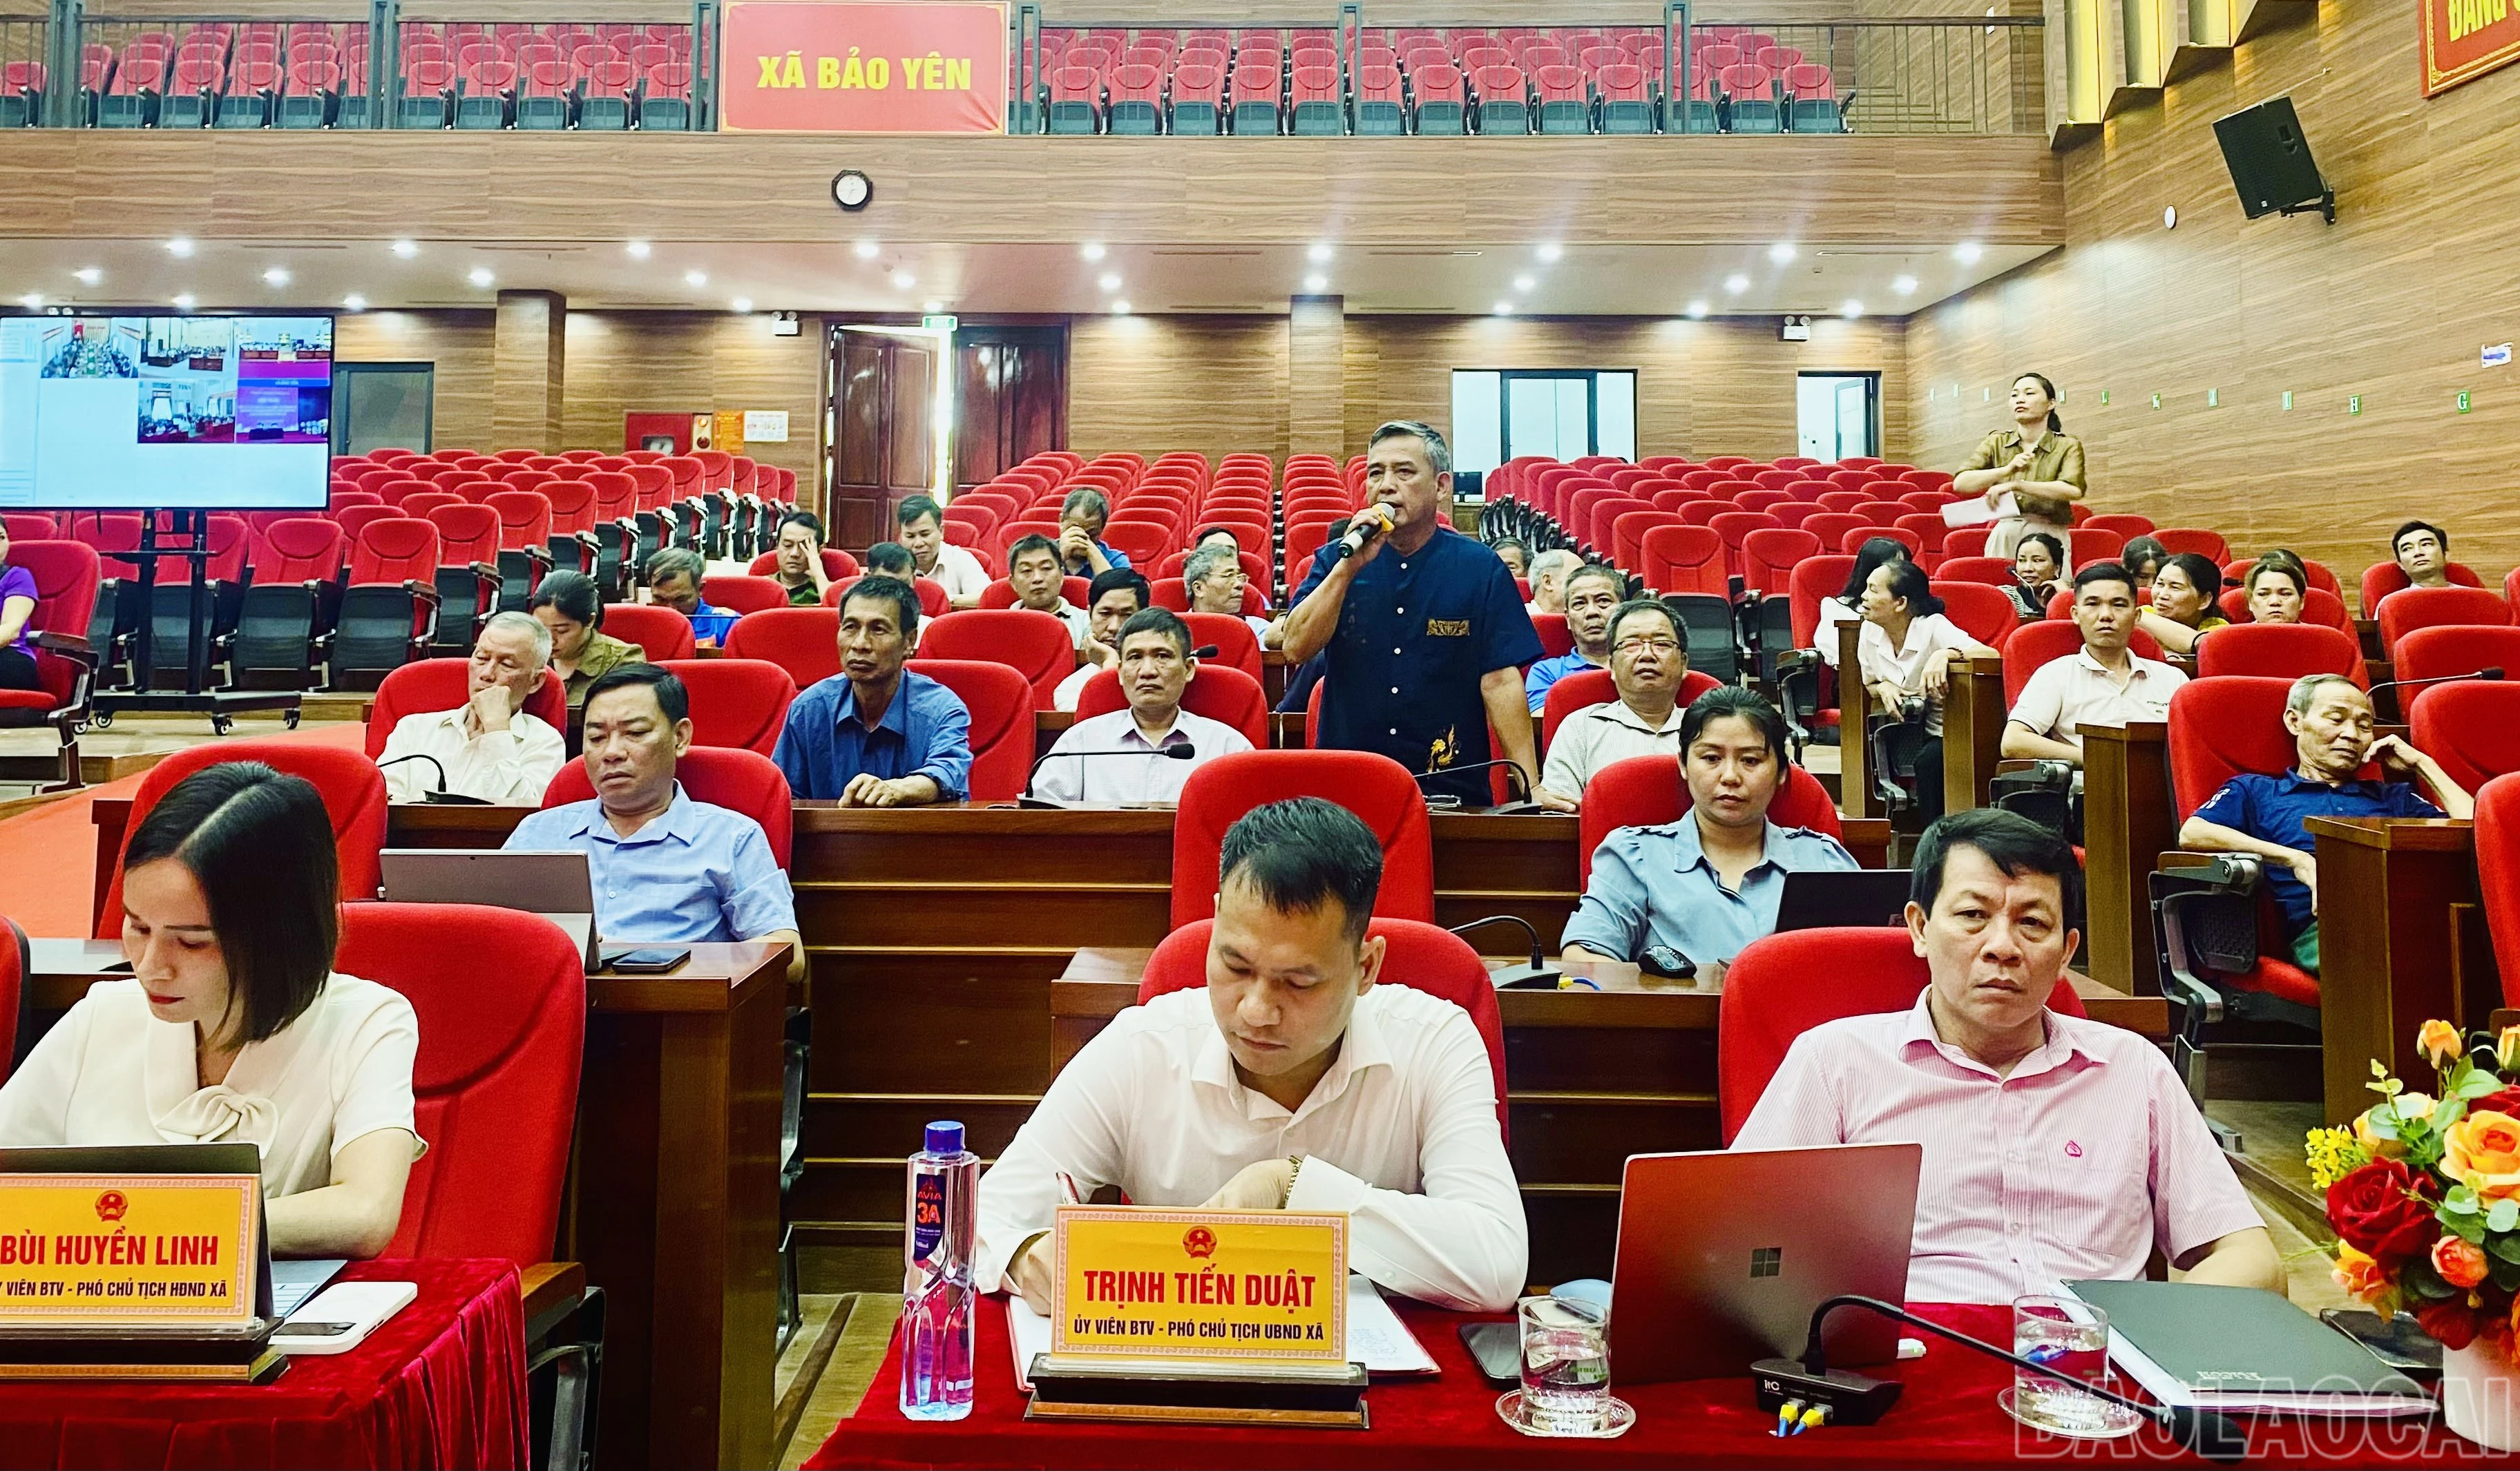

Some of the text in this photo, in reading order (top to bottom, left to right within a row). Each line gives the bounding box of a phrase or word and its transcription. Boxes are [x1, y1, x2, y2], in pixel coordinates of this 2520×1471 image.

[757, 46, 971, 90] XÃ BẢO YÊN
[2350, 397, 2358, 412] H
[2458, 394, 2468, 410] G
[917, 1202, 941, 1224] 3A
[1, 1229, 45, 1265] BÙI
[155, 1236, 218, 1265] LINH
[7, 1279, 35, 1296] VIÊN
[40, 1282, 64, 1296] BTV
[77, 1279, 102, 1296] PHÓ
[108, 1277, 133, 1296] CHỦ
[138, 1282, 166, 1299] TỊCH
[170, 1282, 205, 1296] HĐND
[209, 1280, 227, 1296] XÃ
[1084, 1262, 1315, 1314] TRỊNH TIẾN DUẬT
[1074, 1315, 1090, 1334] ỦY
[1096, 1316, 1125, 1334] VIÊN
[1130, 1322, 1155, 1336] BTV
[1168, 1318, 1194, 1337] PHÓ
[1200, 1318, 1225, 1338] CHỦ
[1230, 1323, 1260, 1342] TỊCH
[1265, 1325, 1301, 1339] UBND
[1306, 1322, 1324, 1340] XÃ
